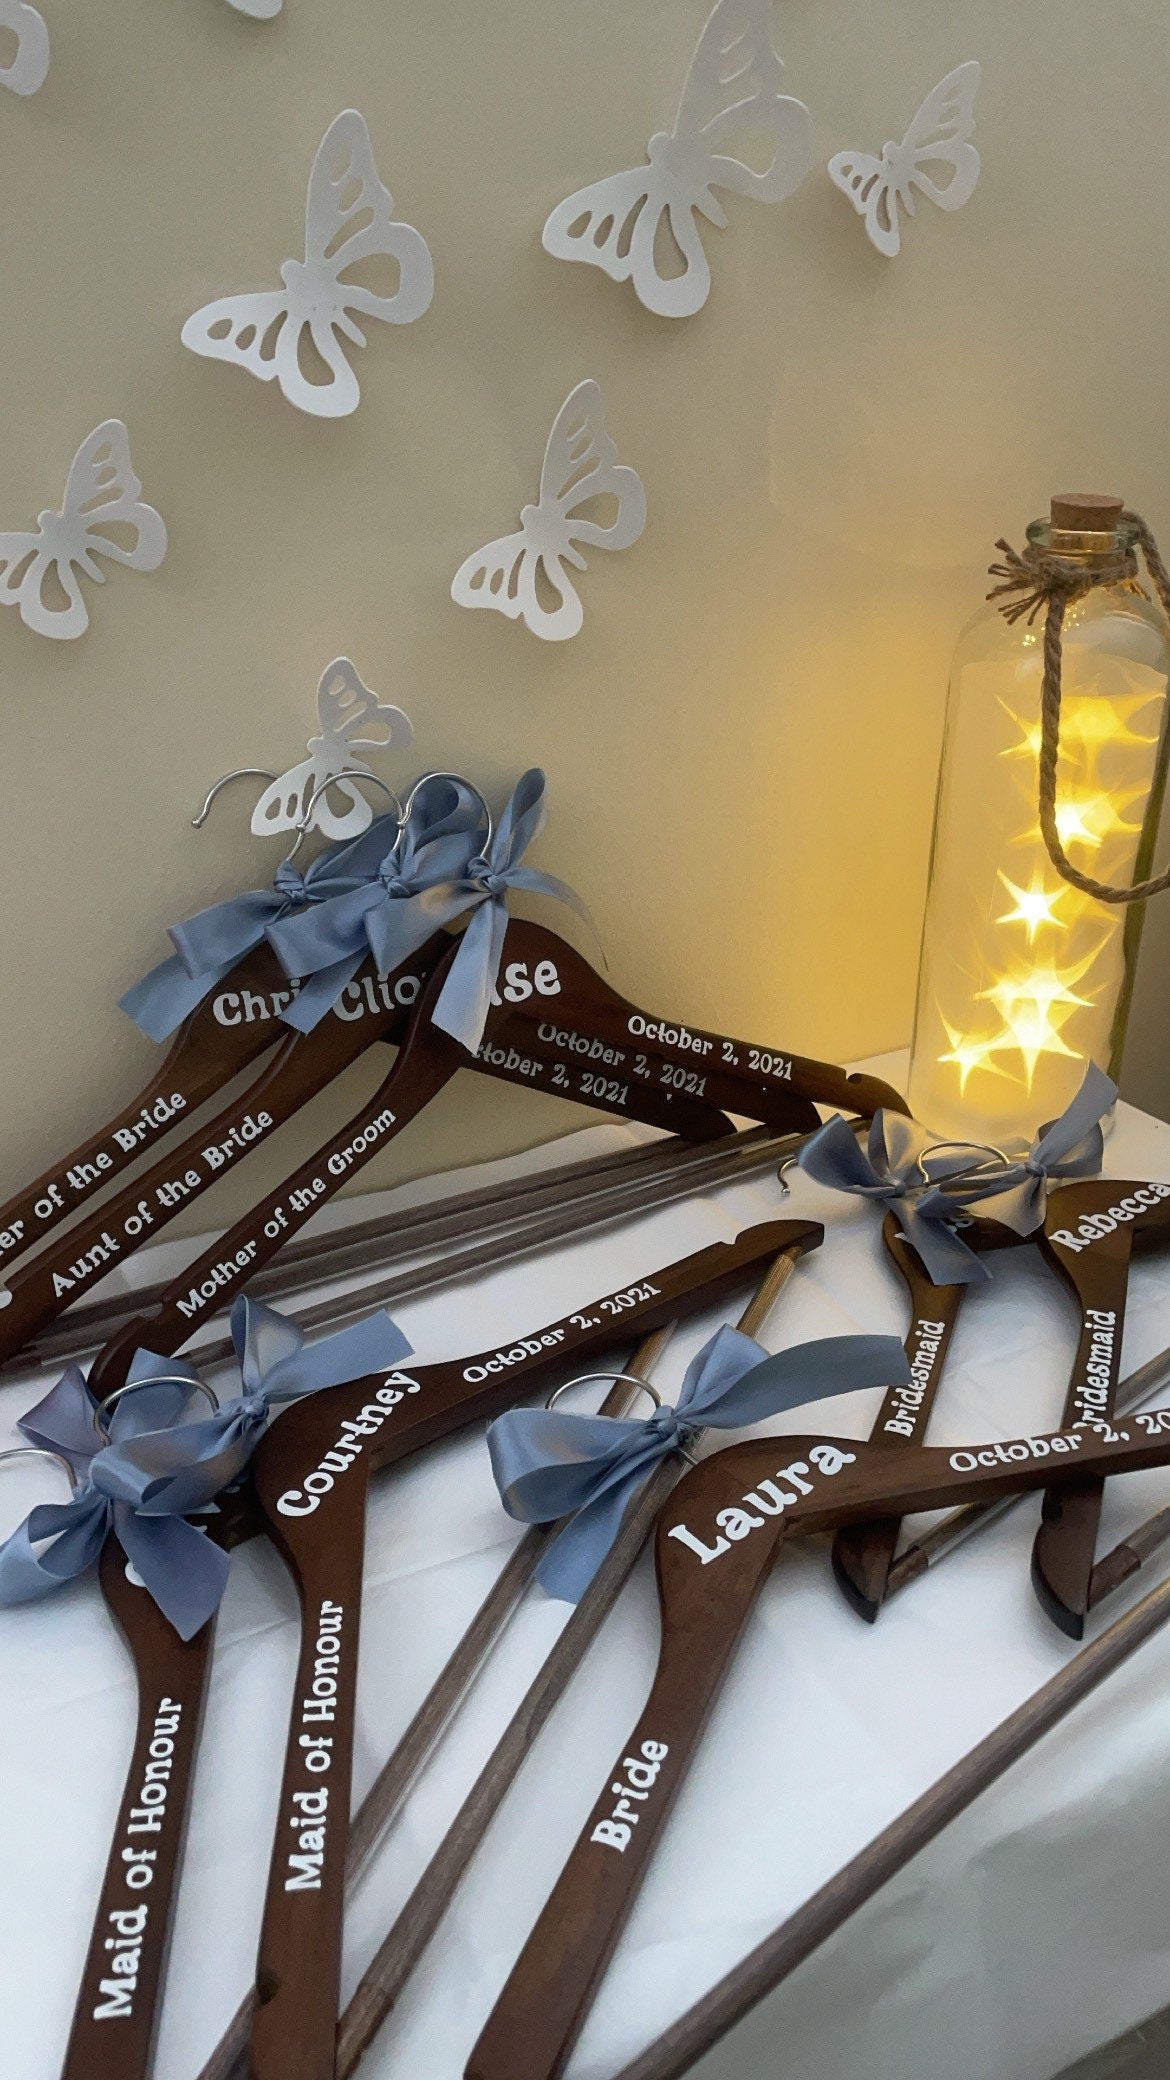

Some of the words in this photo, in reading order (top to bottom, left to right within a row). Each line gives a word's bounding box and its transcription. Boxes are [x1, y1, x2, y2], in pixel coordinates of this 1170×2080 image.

[333, 973, 426, 1021] Clio
[491, 960, 562, 1006] se
[471, 1042, 543, 1077] tober
[551, 1063, 570, 1088] 2,
[579, 1072, 629, 1105] 2021
[537, 1023, 625, 1066] October
[633, 1055, 651, 1079] 2,
[660, 1063, 707, 1095] 2021
[628, 1015, 711, 1055] October
[722, 1042, 739, 1065] 2,
[748, 1051, 793, 1081] 2021
[0, 1220, 24, 1257] er
[34, 1184, 65, 1218] of
[66, 1151, 113, 1190] the
[112, 1093, 187, 1152] Bride
[52, 1233, 120, 1298] Aunt
[124, 1201, 161, 1236] of
[157, 1172, 202, 1208] the
[201, 1109, 273, 1171] Bride
[175, 1242, 257, 1318] Mother
[264, 1207, 289, 1239] of
[290, 1179, 327, 1213] the
[327, 1109, 397, 1176] Groom
[1048, 1183, 1170, 1253] Rebecca
[462, 1330, 565, 1383] October
[570, 1315, 601, 1330] 2,
[600, 1283, 662, 1314] 2021
[884, 1319, 946, 1437] Bridesmaid
[1072, 1309, 1117, 1428] ridesmaid
[276, 1370, 421, 1517] Courtney
[949, 1434, 1083, 1472] October
[1092, 1423, 1130, 1443] 2,
[667, 1444, 857, 1565] Laura
[302, 1600, 343, 1722] Honour
[127, 1698, 182, 1834] Honour
[298, 1734, 333, 1773] of
[590, 1739, 669, 1853] Bride
[121, 1846, 157, 1889] of
[284, 1787, 329, 1892] Maid
[94, 1904, 148, 2020] Maid
